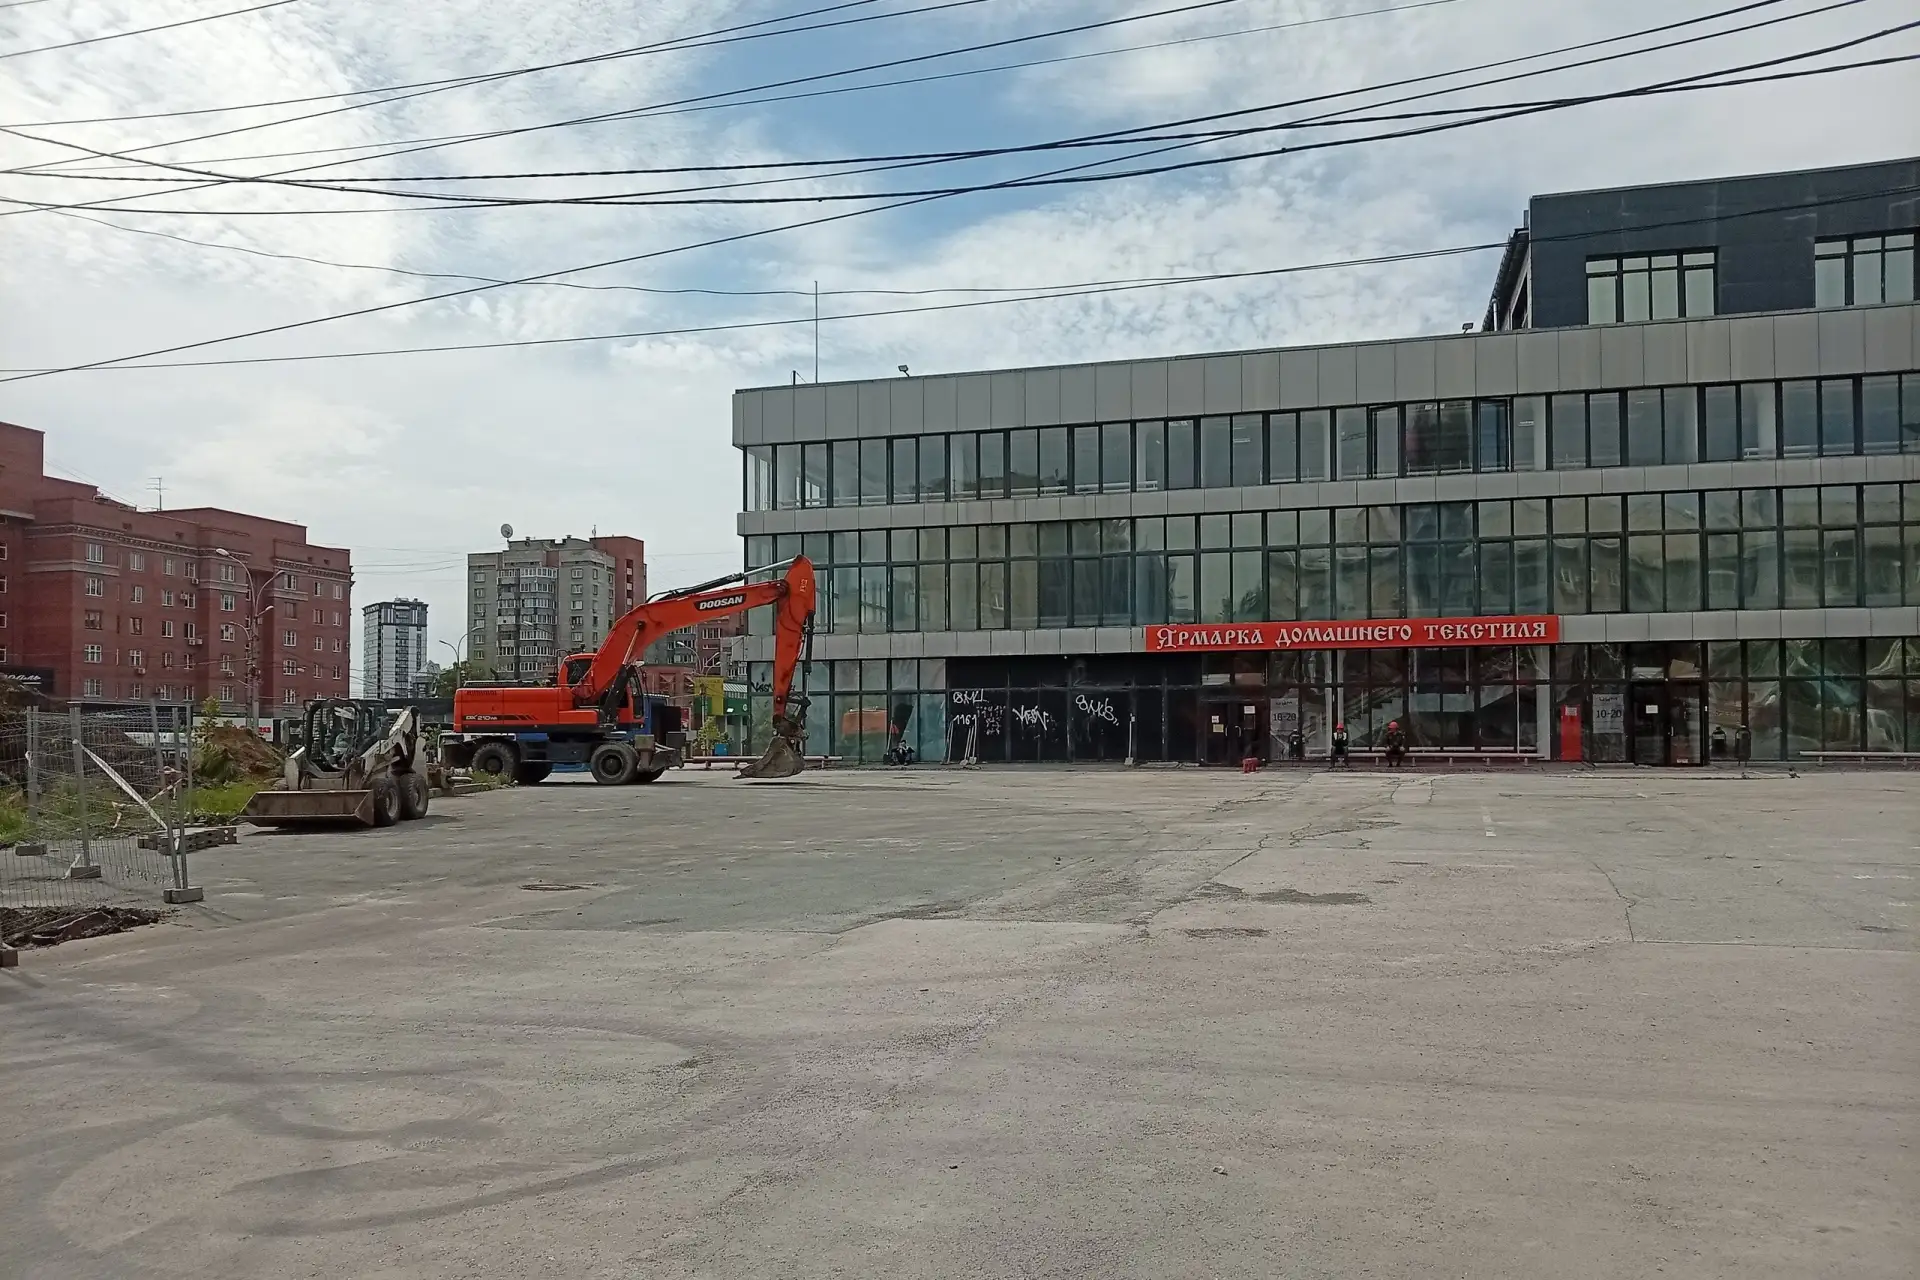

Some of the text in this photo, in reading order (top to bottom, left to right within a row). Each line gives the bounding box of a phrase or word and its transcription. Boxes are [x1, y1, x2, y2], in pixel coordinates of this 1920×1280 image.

[699, 595, 743, 610] DOOSAN
[1273, 712, 1297, 722] 10-20
[1596, 709, 1622, 719] 10-20
